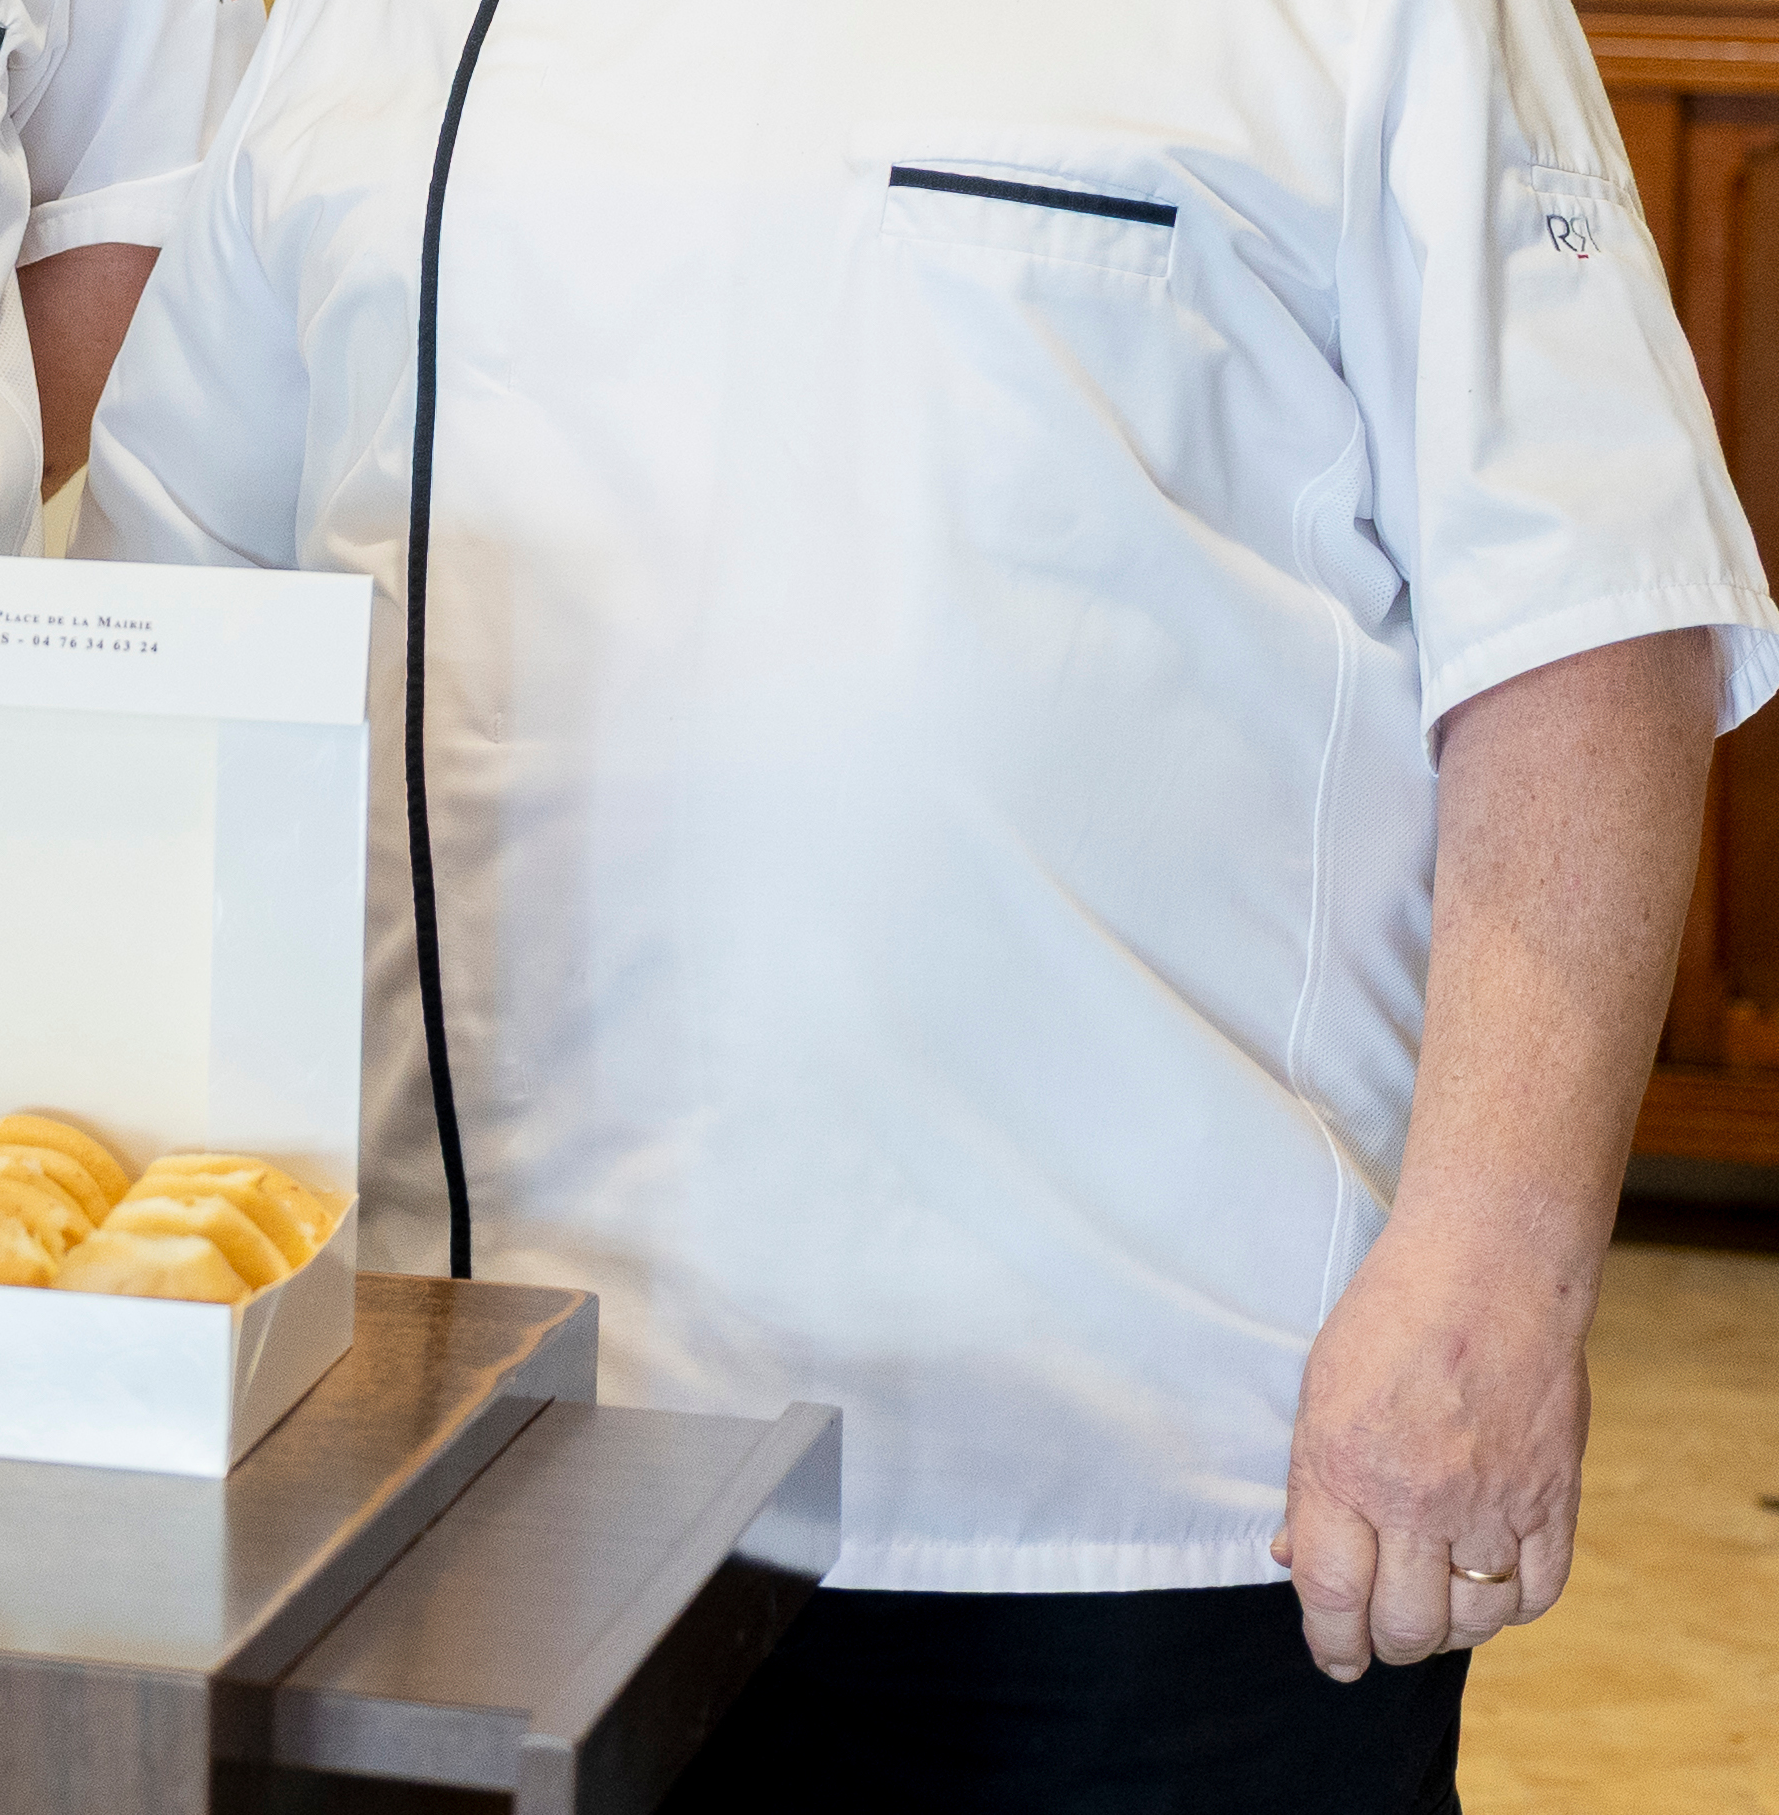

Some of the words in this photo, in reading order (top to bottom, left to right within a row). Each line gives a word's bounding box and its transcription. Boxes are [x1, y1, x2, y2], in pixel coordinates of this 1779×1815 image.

[32, 634, 50, 647] 04
[60, 636, 78, 649] 76
[86, 637, 104, 650] 34
[113, 638, 131, 652] 63
[140, 640, 159, 654] 24
